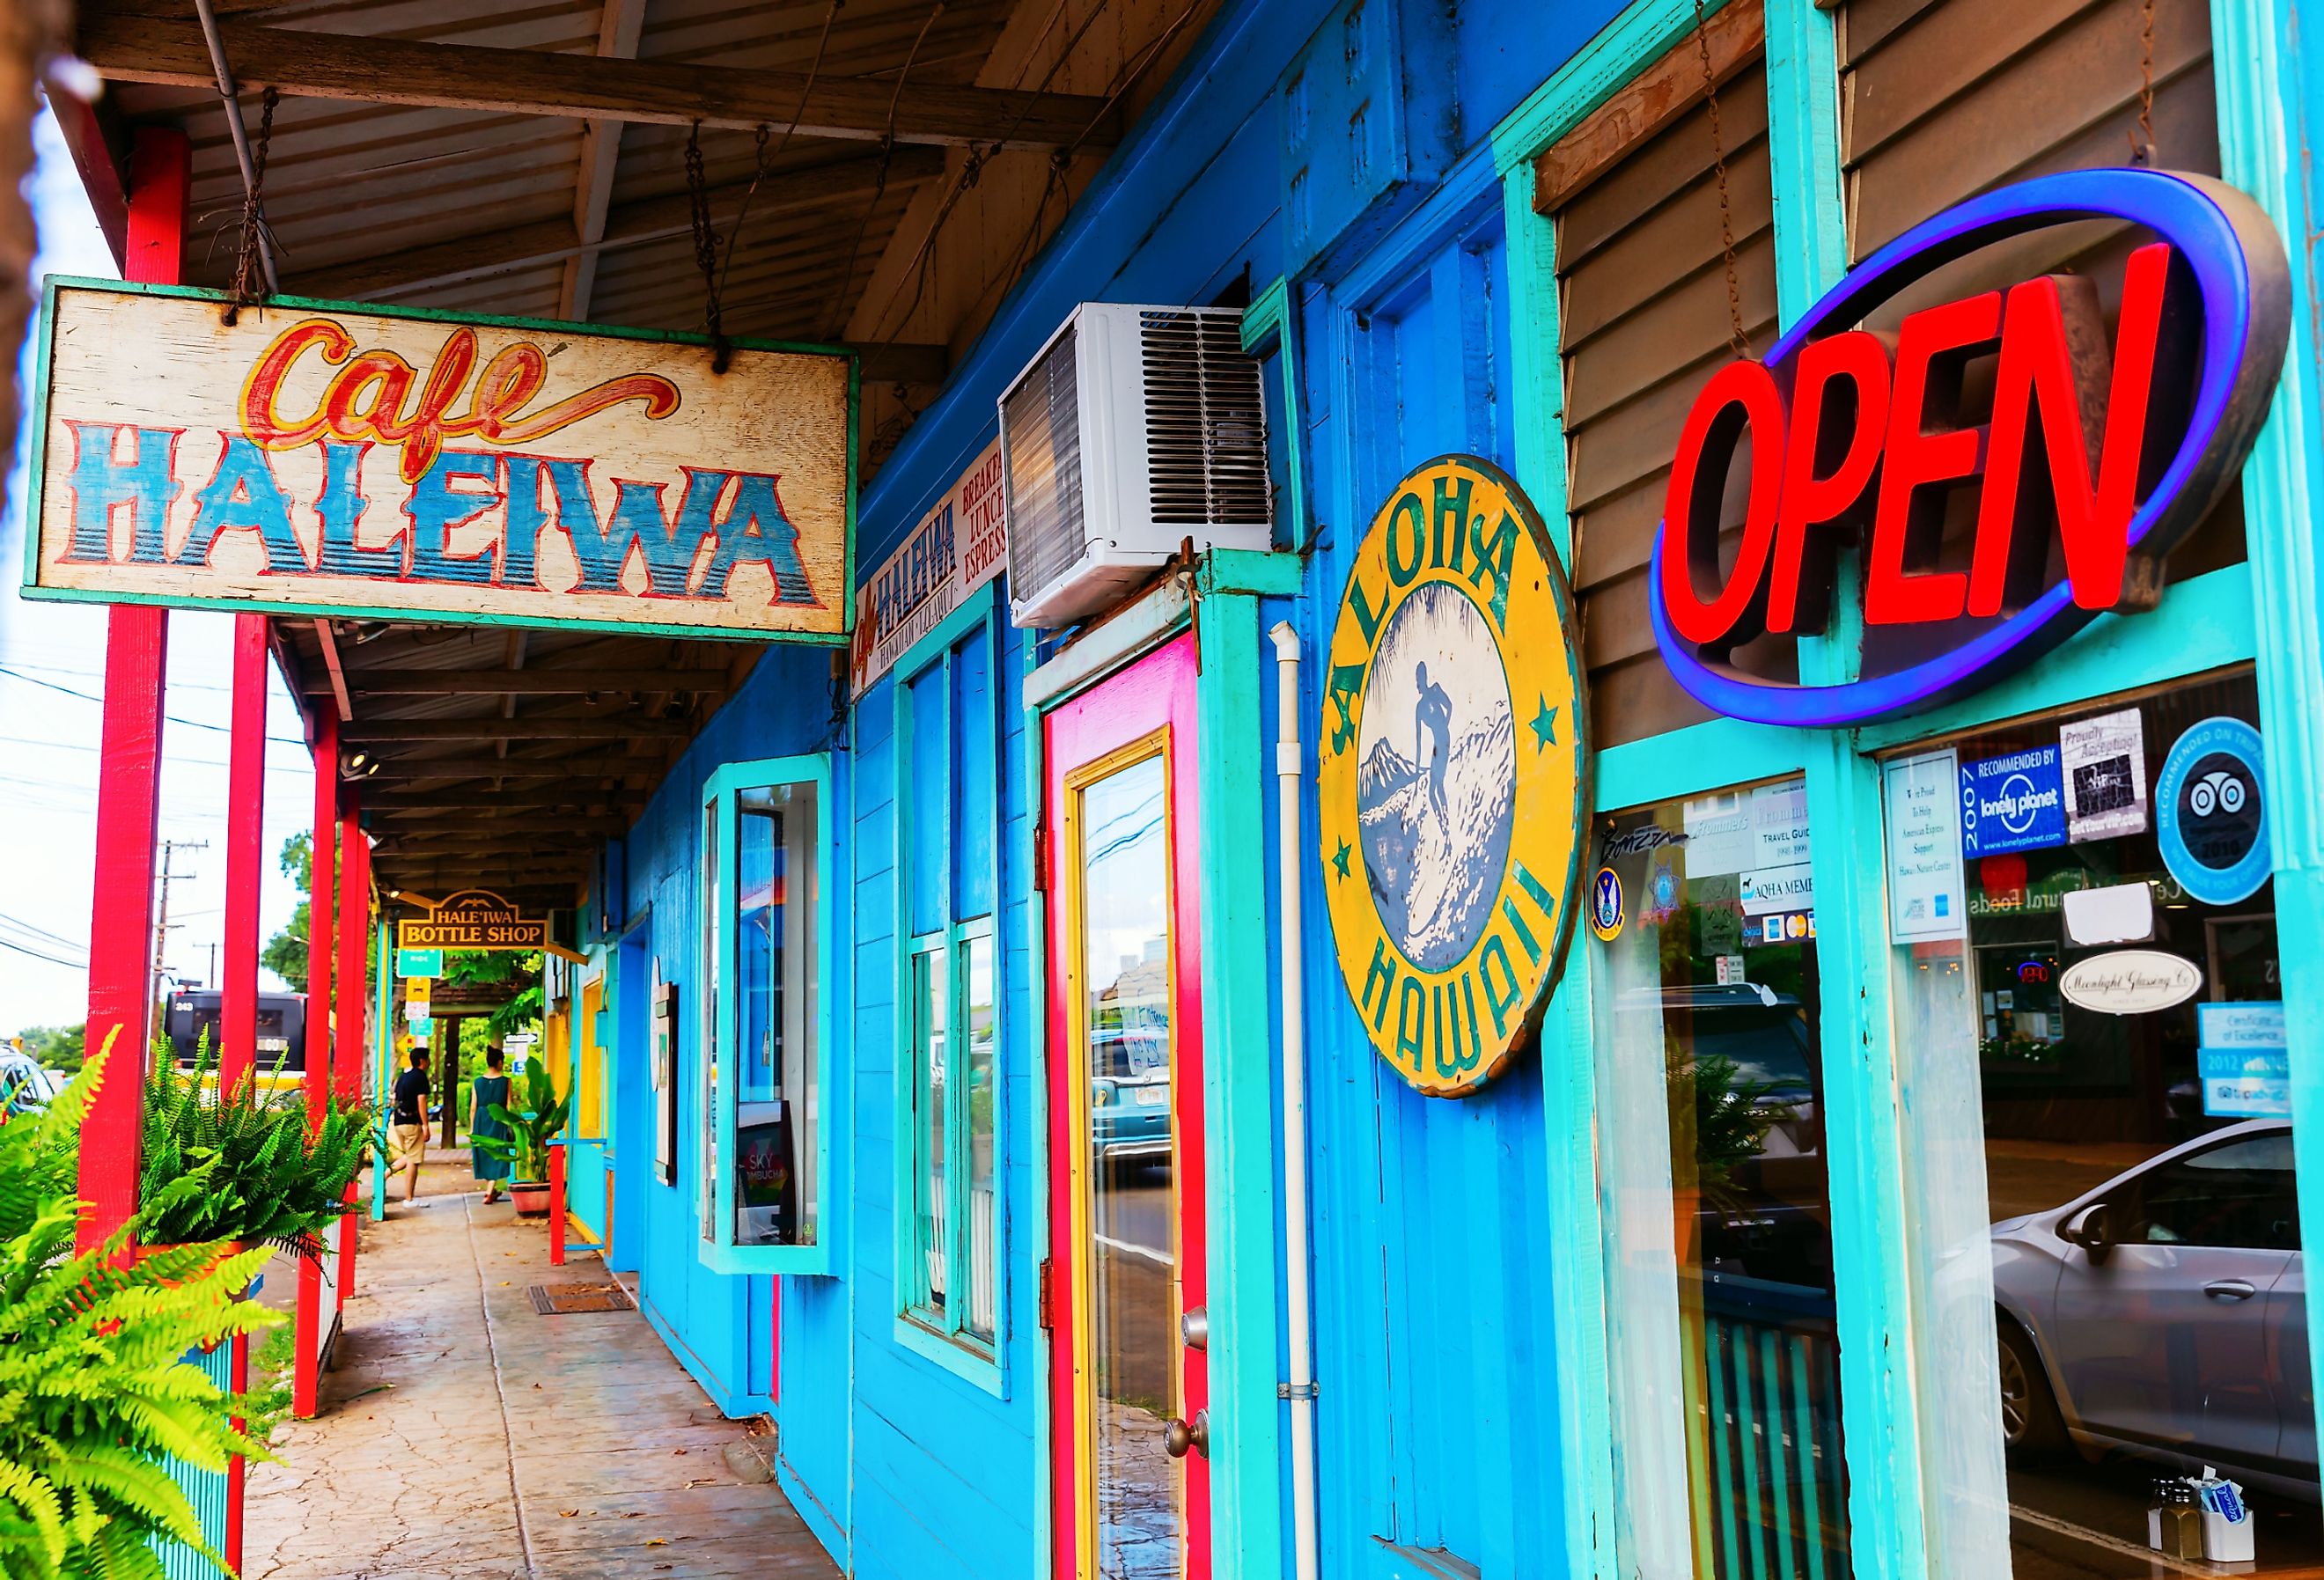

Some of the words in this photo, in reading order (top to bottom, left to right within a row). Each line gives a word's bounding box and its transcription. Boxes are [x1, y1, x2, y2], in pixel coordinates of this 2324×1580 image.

[238, 317, 681, 484] Café
[1661, 243, 2170, 643] OPEN
[55, 420, 827, 609] HALEIWA
[970, 485, 1004, 544] LUNCH
[1329, 476, 1521, 758] ALOHA
[1978, 754, 2042, 777] RECOMMENDED
[2043, 748, 2055, 764] BY
[2161, 730, 2212, 829] RECOMMENDED
[2214, 728, 2232, 740] ON
[1962, 767, 1979, 851] 2007
[1981, 793, 2016, 819] lonely
[2018, 787, 2058, 817] planet
[1762, 830, 1791, 844] TRAVEL
[1983, 832, 2061, 850] www.lonelyplanet.com
[1754, 882, 1783, 900] AQHA
[406, 926, 482, 943] BOTTLE
[487, 925, 541, 943] SHOP
[1361, 859, 1555, 1080] HAWAII
[2208, 1055, 2239, 1071] 2012
[749, 1153, 773, 1170] SKY
